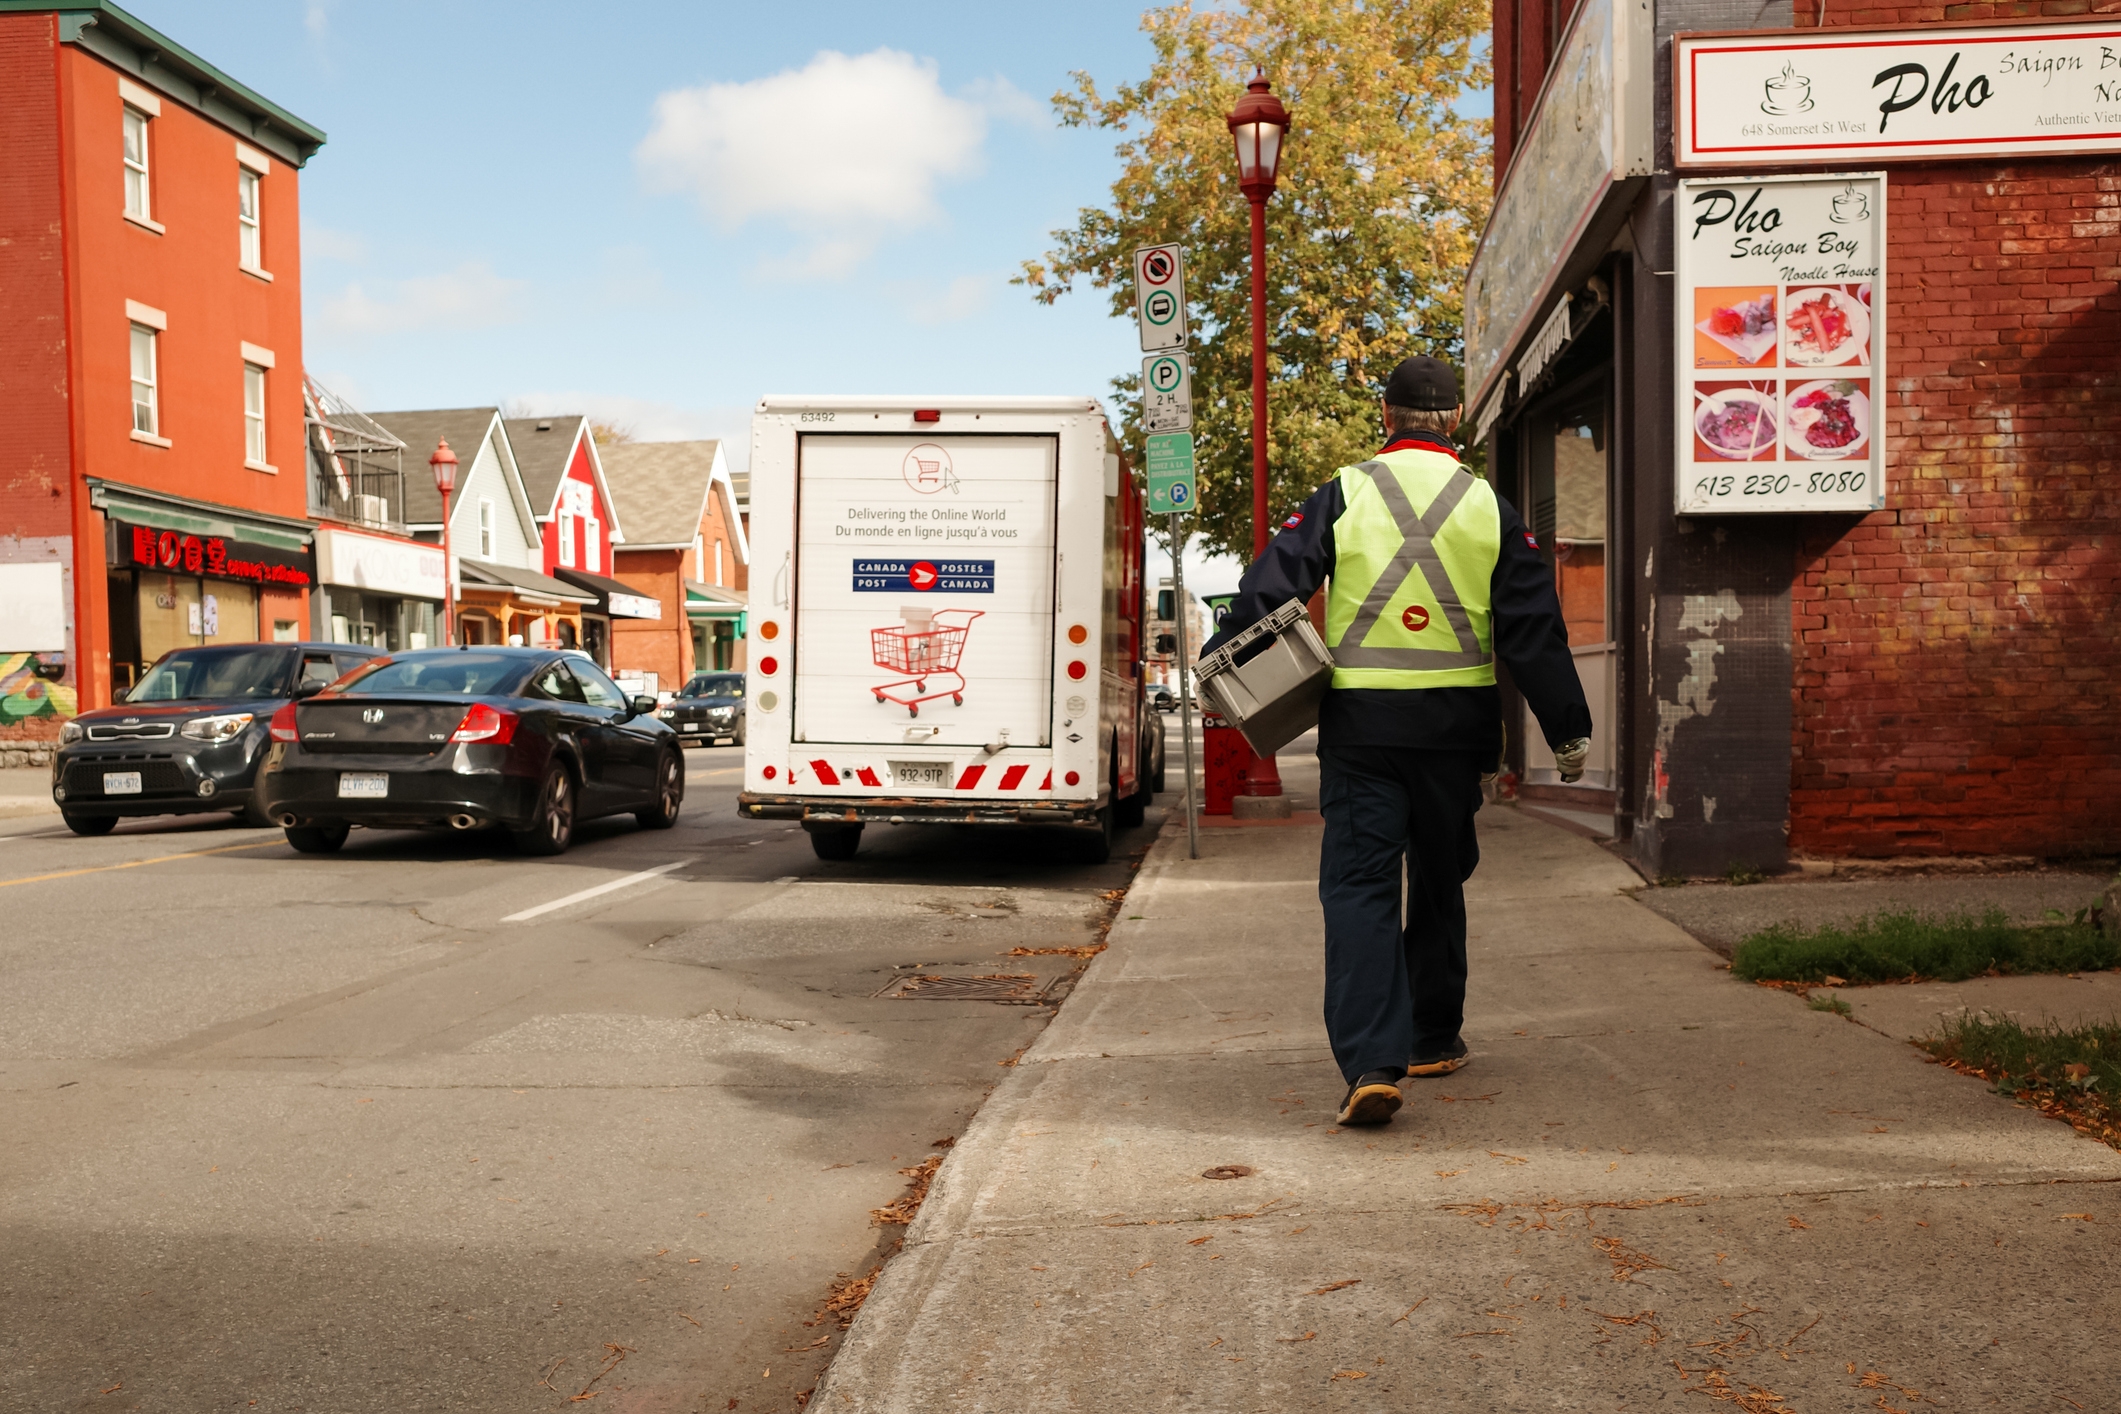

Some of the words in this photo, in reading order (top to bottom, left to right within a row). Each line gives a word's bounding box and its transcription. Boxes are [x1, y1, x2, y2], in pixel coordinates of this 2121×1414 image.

[2000, 50, 2083, 88] Saigon
[2100, 46, 2121, 70] B
[1872, 52, 1994, 134] Pho
[2034, 112, 2090, 126] Authentic
[1742, 124, 1763, 136] 648
[1767, 123, 1819, 136] Somerset
[1822, 121, 1834, 134] St
[1837, 120, 1867, 133] West
[1692, 187, 1783, 240] Pho
[1730, 237, 1808, 263] Saigon
[1817, 231, 1859, 259] Boy
[1779, 266, 1829, 281] Noodle
[1832, 263, 1879, 279] House
[1160, 366, 1172, 385] P
[1157, 395, 1163, 405] 2
[801, 412, 835, 422] 63492
[848, 508, 906, 522] Delivering
[909, 508, 928, 520] the
[931, 508, 968, 520] Online
[972, 509, 1006, 521] World
[836, 525, 851, 536] Du
[854, 525, 894, 537] monde
[897, 528, 911, 537] en
[915, 526, 943, 540] ligne
[991, 529, 1018, 538] vous
[858, 563, 907, 572] CANADA
[941, 564, 984, 573] POSTES
[858, 579, 887, 587] POST
[941, 580, 989, 589] CANADA
